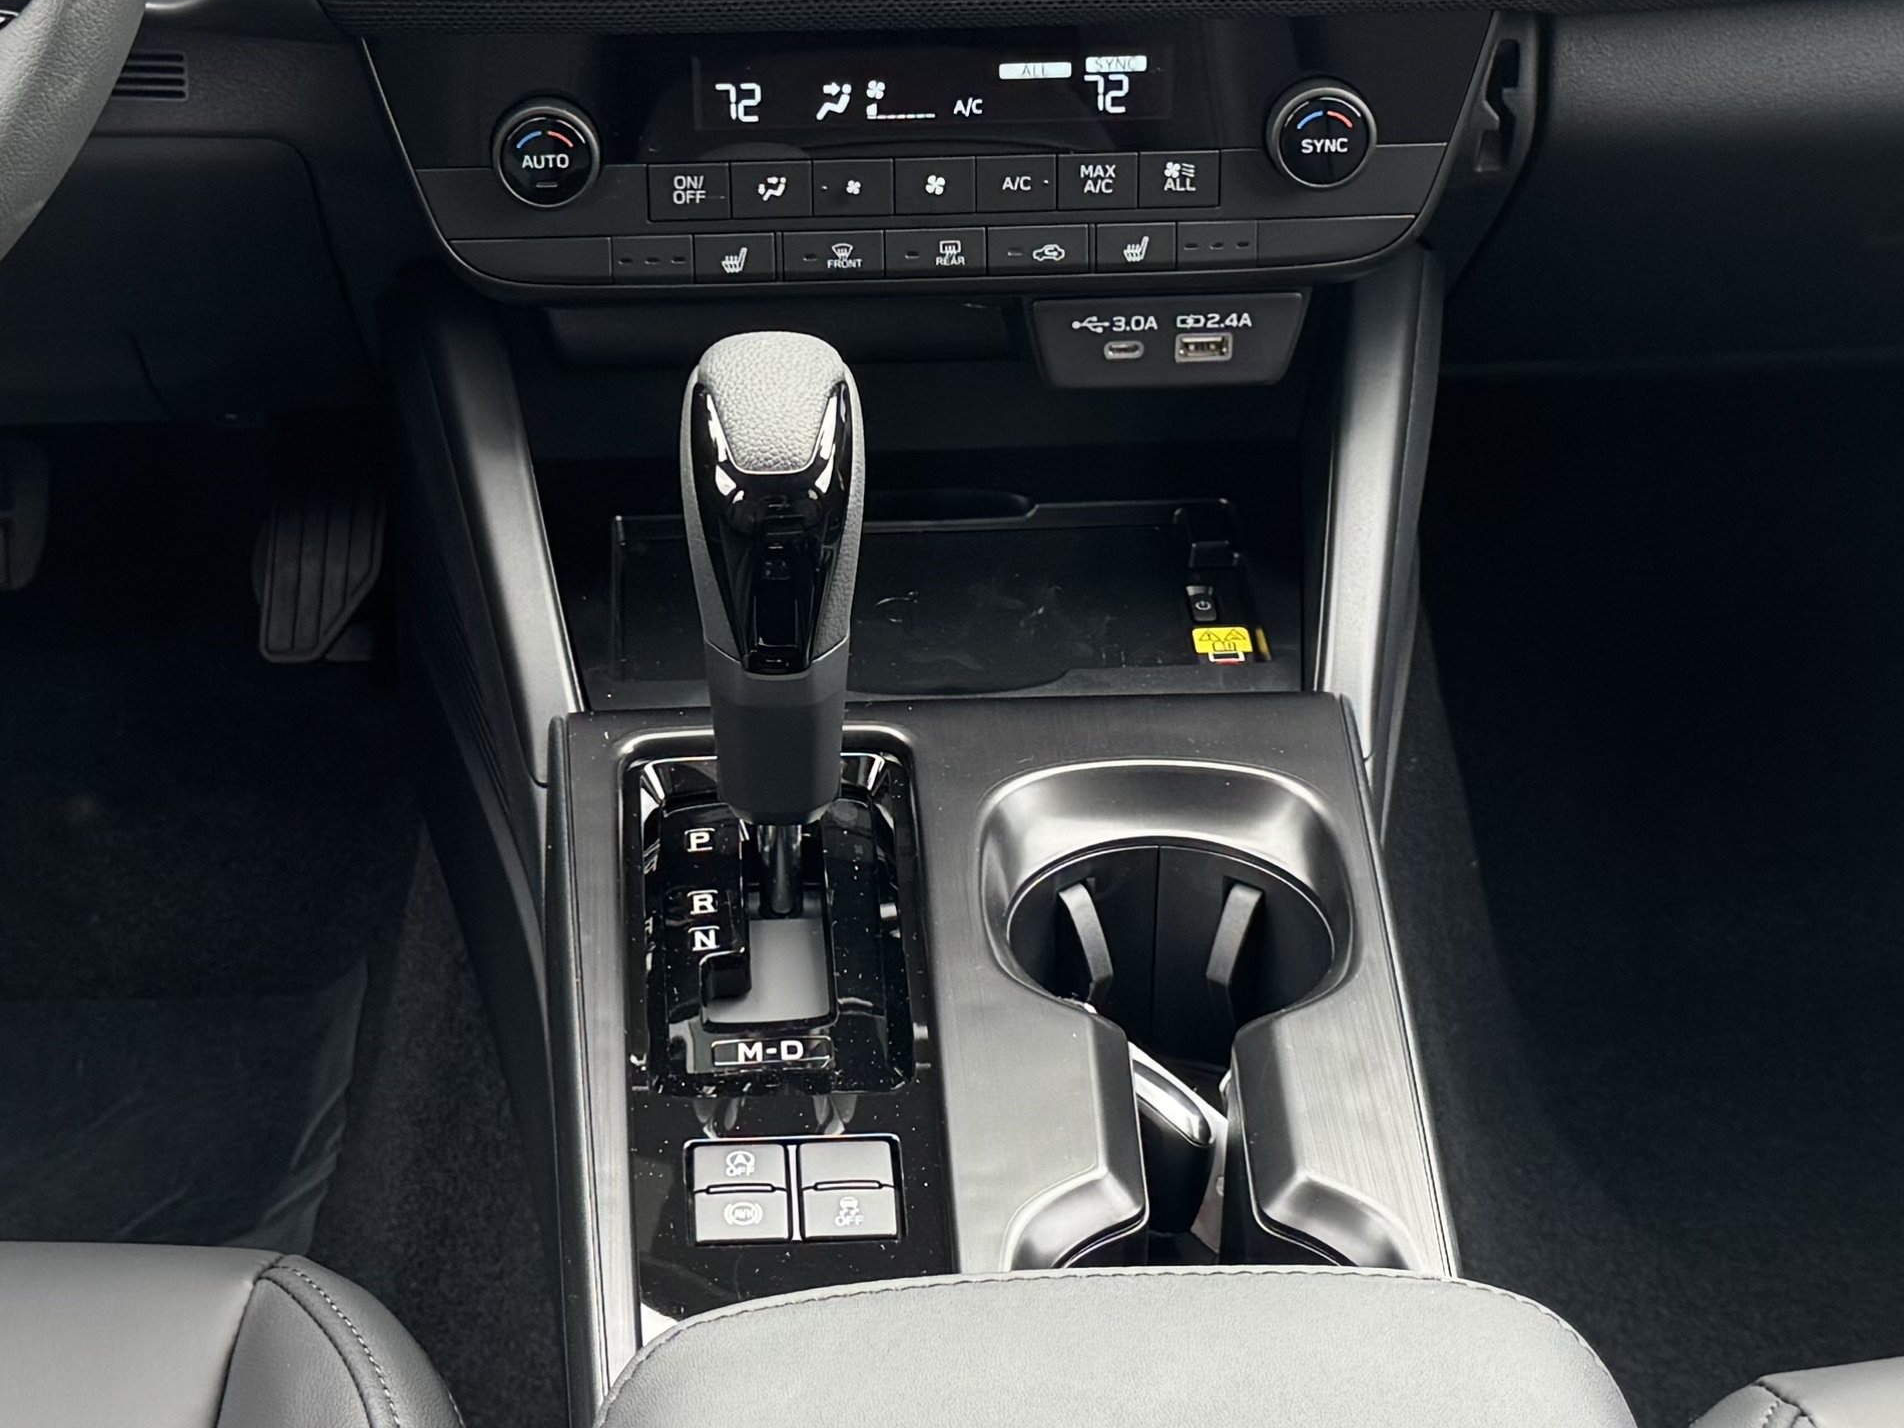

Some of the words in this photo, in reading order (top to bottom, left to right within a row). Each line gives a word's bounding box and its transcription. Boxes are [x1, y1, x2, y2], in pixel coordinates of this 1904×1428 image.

[1084, 73, 1129, 113] 72
[715, 82, 761, 122] 72
[953, 97, 982, 117] A/C
[1301, 137, 1348, 153] SYNC
[522, 153, 569, 169] AUTO
[1080, 164, 1115, 178] MAX
[673, 175, 704, 190] ON/
[1002, 176, 1031, 190] A/C
[1083, 179, 1113, 194] A/C
[1163, 176, 1196, 191] ALL
[673, 191, 707, 205] OFF
[827, 255, 862, 268] FRONT
[935, 252, 965, 266] REAR
[1112, 315, 1158, 331] 3.0A
[1206, 312, 1252, 328] 2.4A
[689, 832, 712, 852] P
[692, 894, 715, 914] R
[692, 929, 718, 950] N
[834, 1212, 865, 1228] OFF
